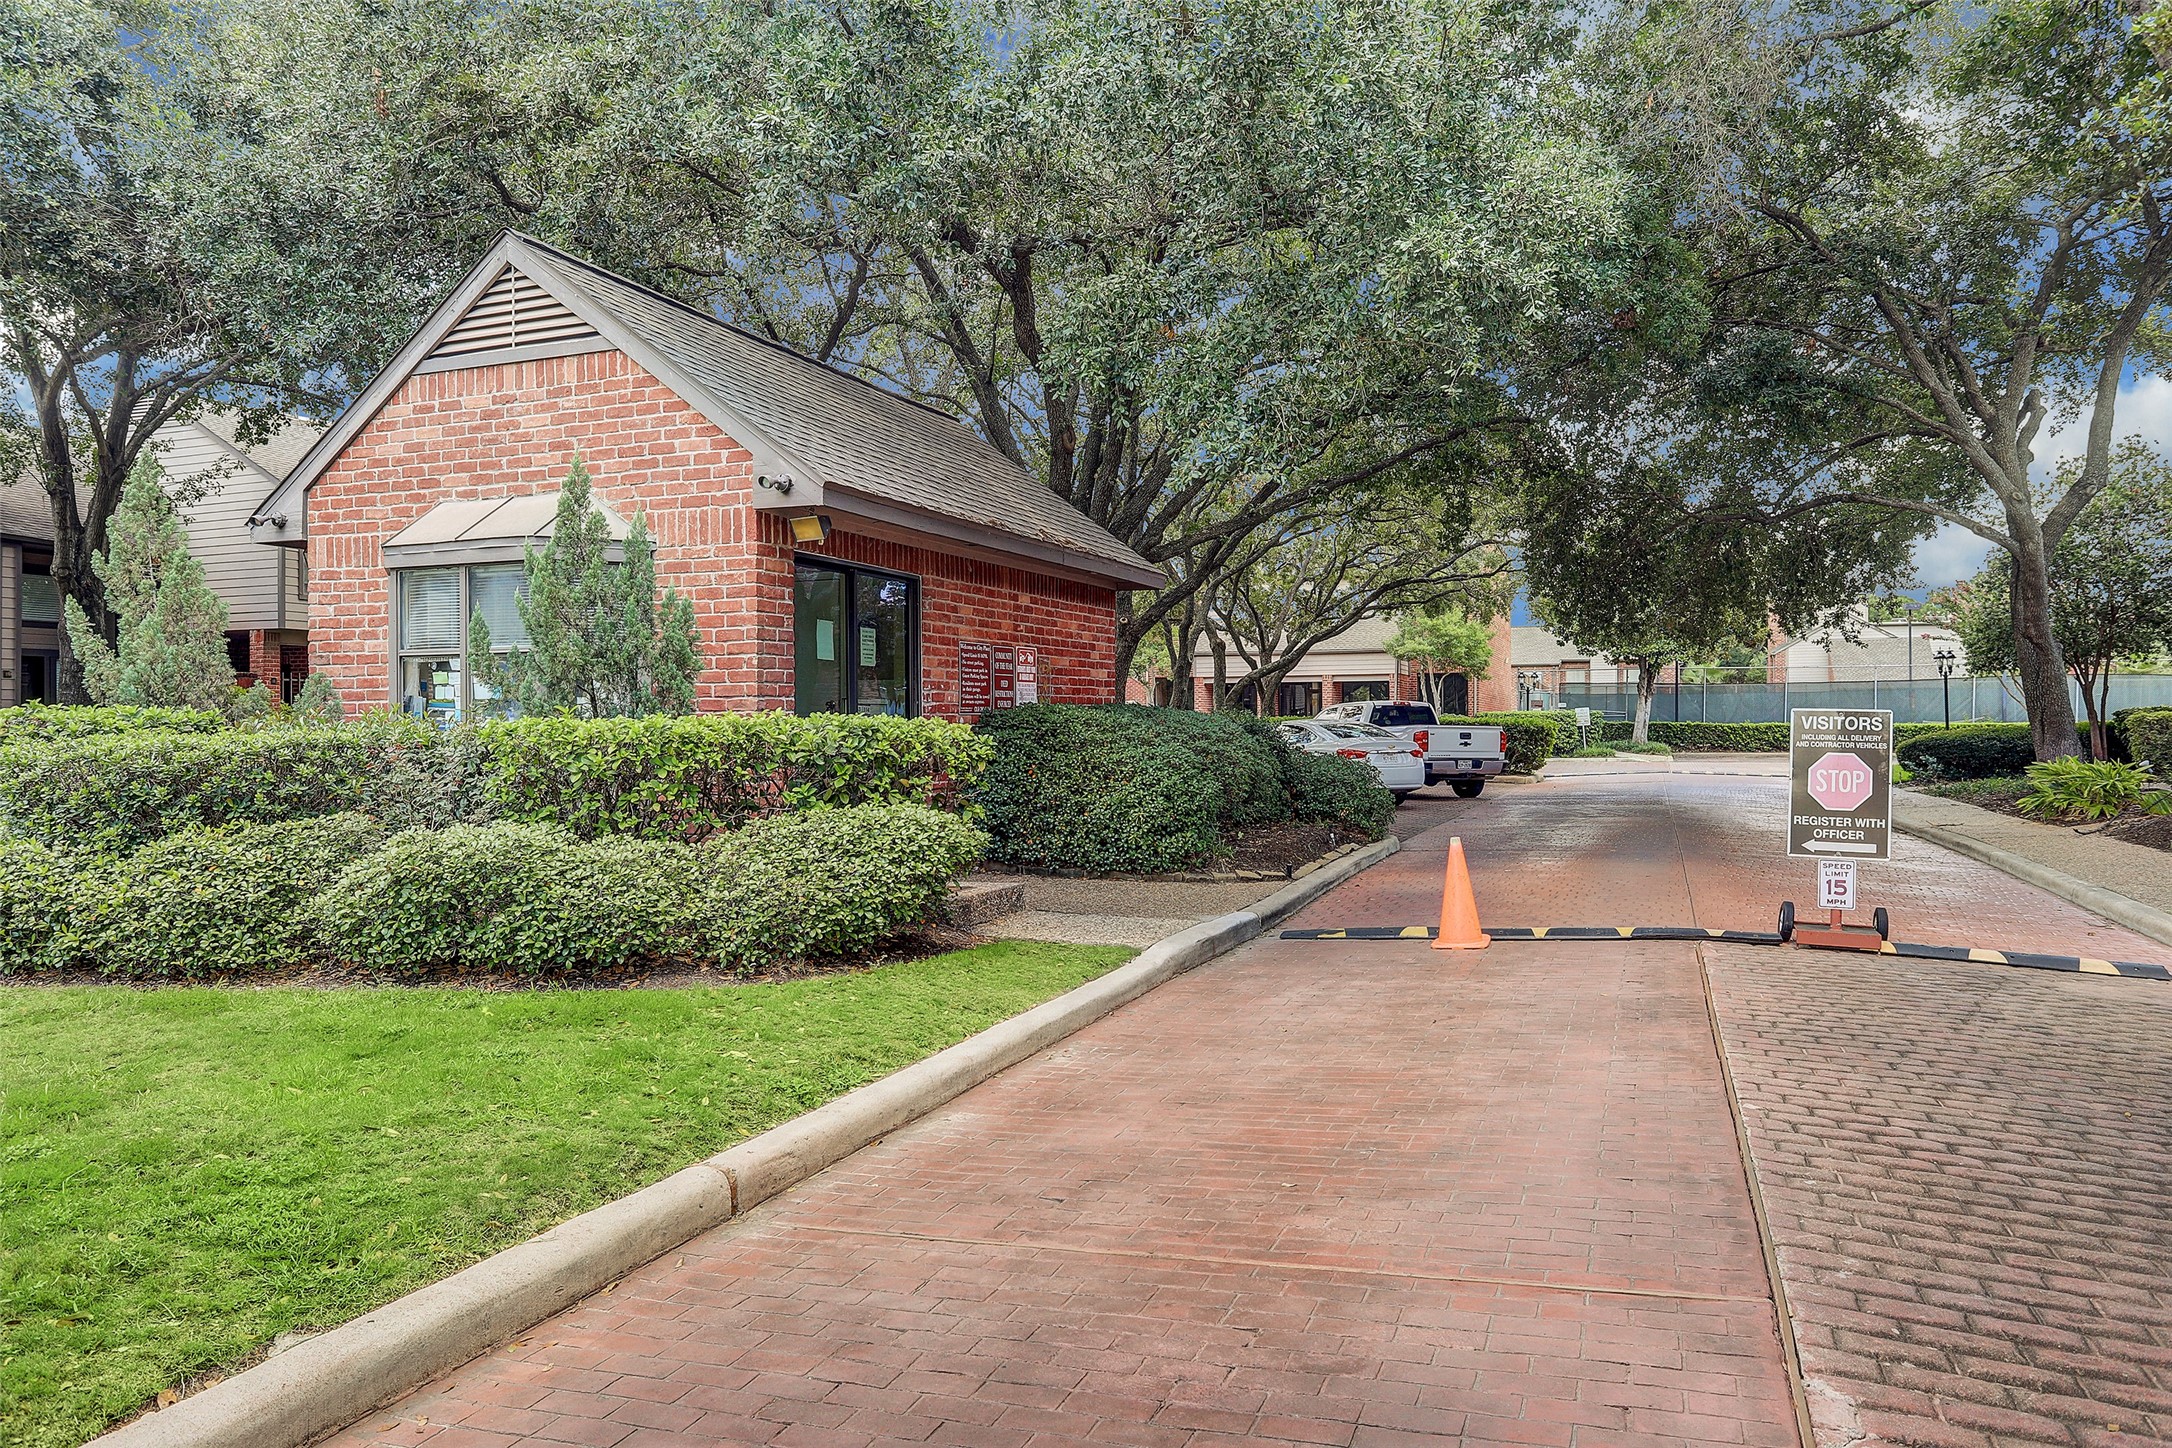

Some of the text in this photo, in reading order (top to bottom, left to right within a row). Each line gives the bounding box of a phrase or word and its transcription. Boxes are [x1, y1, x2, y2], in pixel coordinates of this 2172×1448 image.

[1801, 716, 1883, 731] VISITORS
[1816, 769, 1864, 794] STOP
[1794, 816, 1885, 828] REGISTER WITH
[1813, 828, 1864, 840] OFFICER
[1826, 880, 1848, 896] 15
